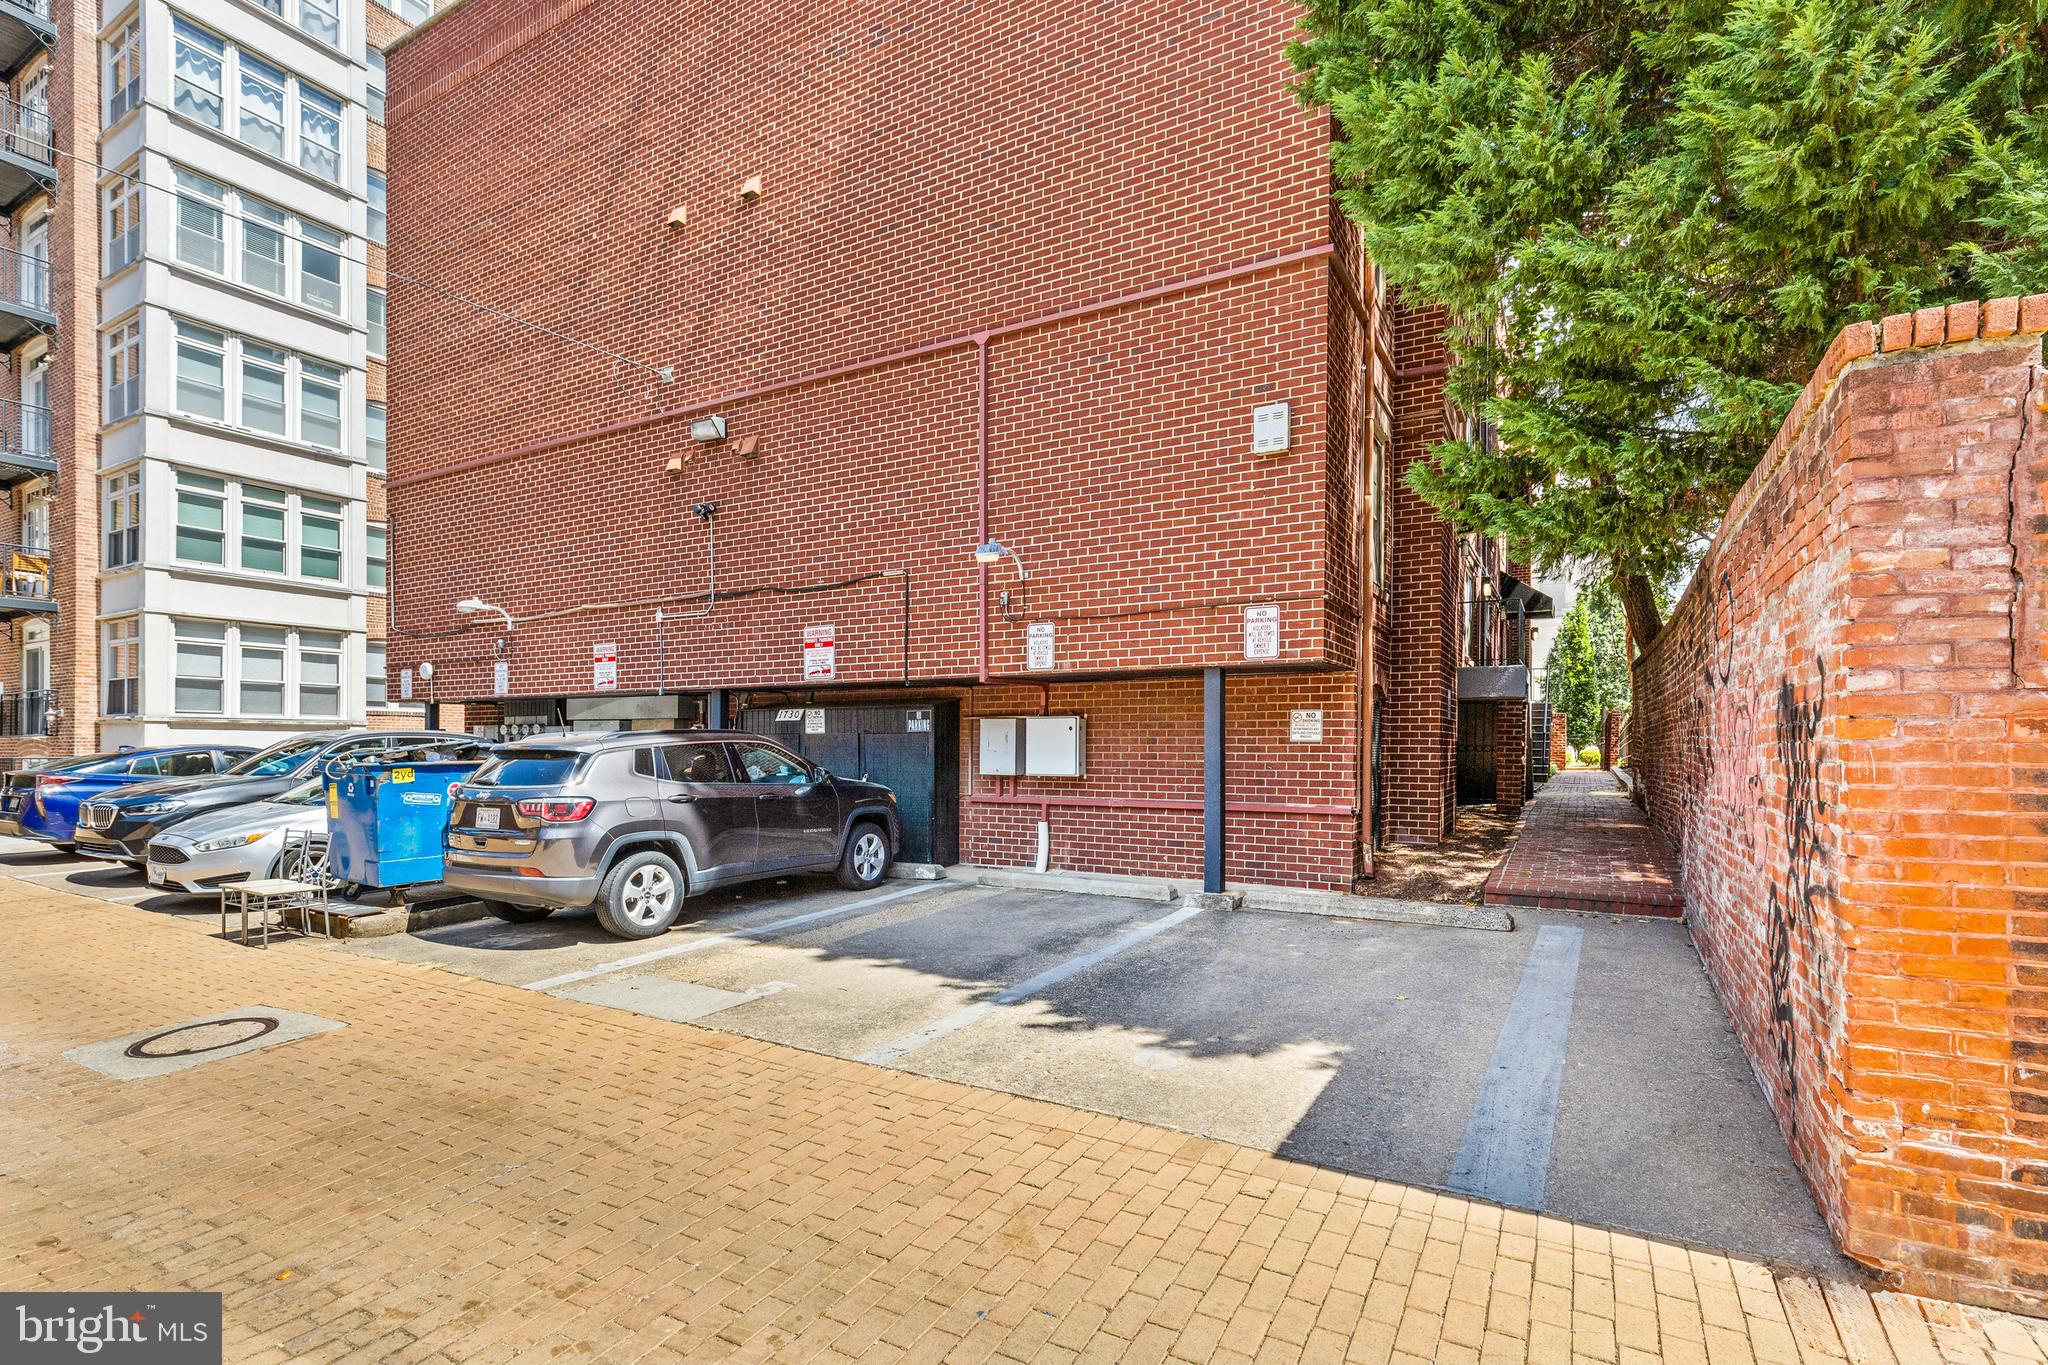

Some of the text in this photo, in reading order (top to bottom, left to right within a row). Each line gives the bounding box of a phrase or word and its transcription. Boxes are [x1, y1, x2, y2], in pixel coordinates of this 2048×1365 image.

[806, 629, 832, 637] WARNING
[778, 710, 800, 719] 1730
[394, 768, 414, 780] 2yd
